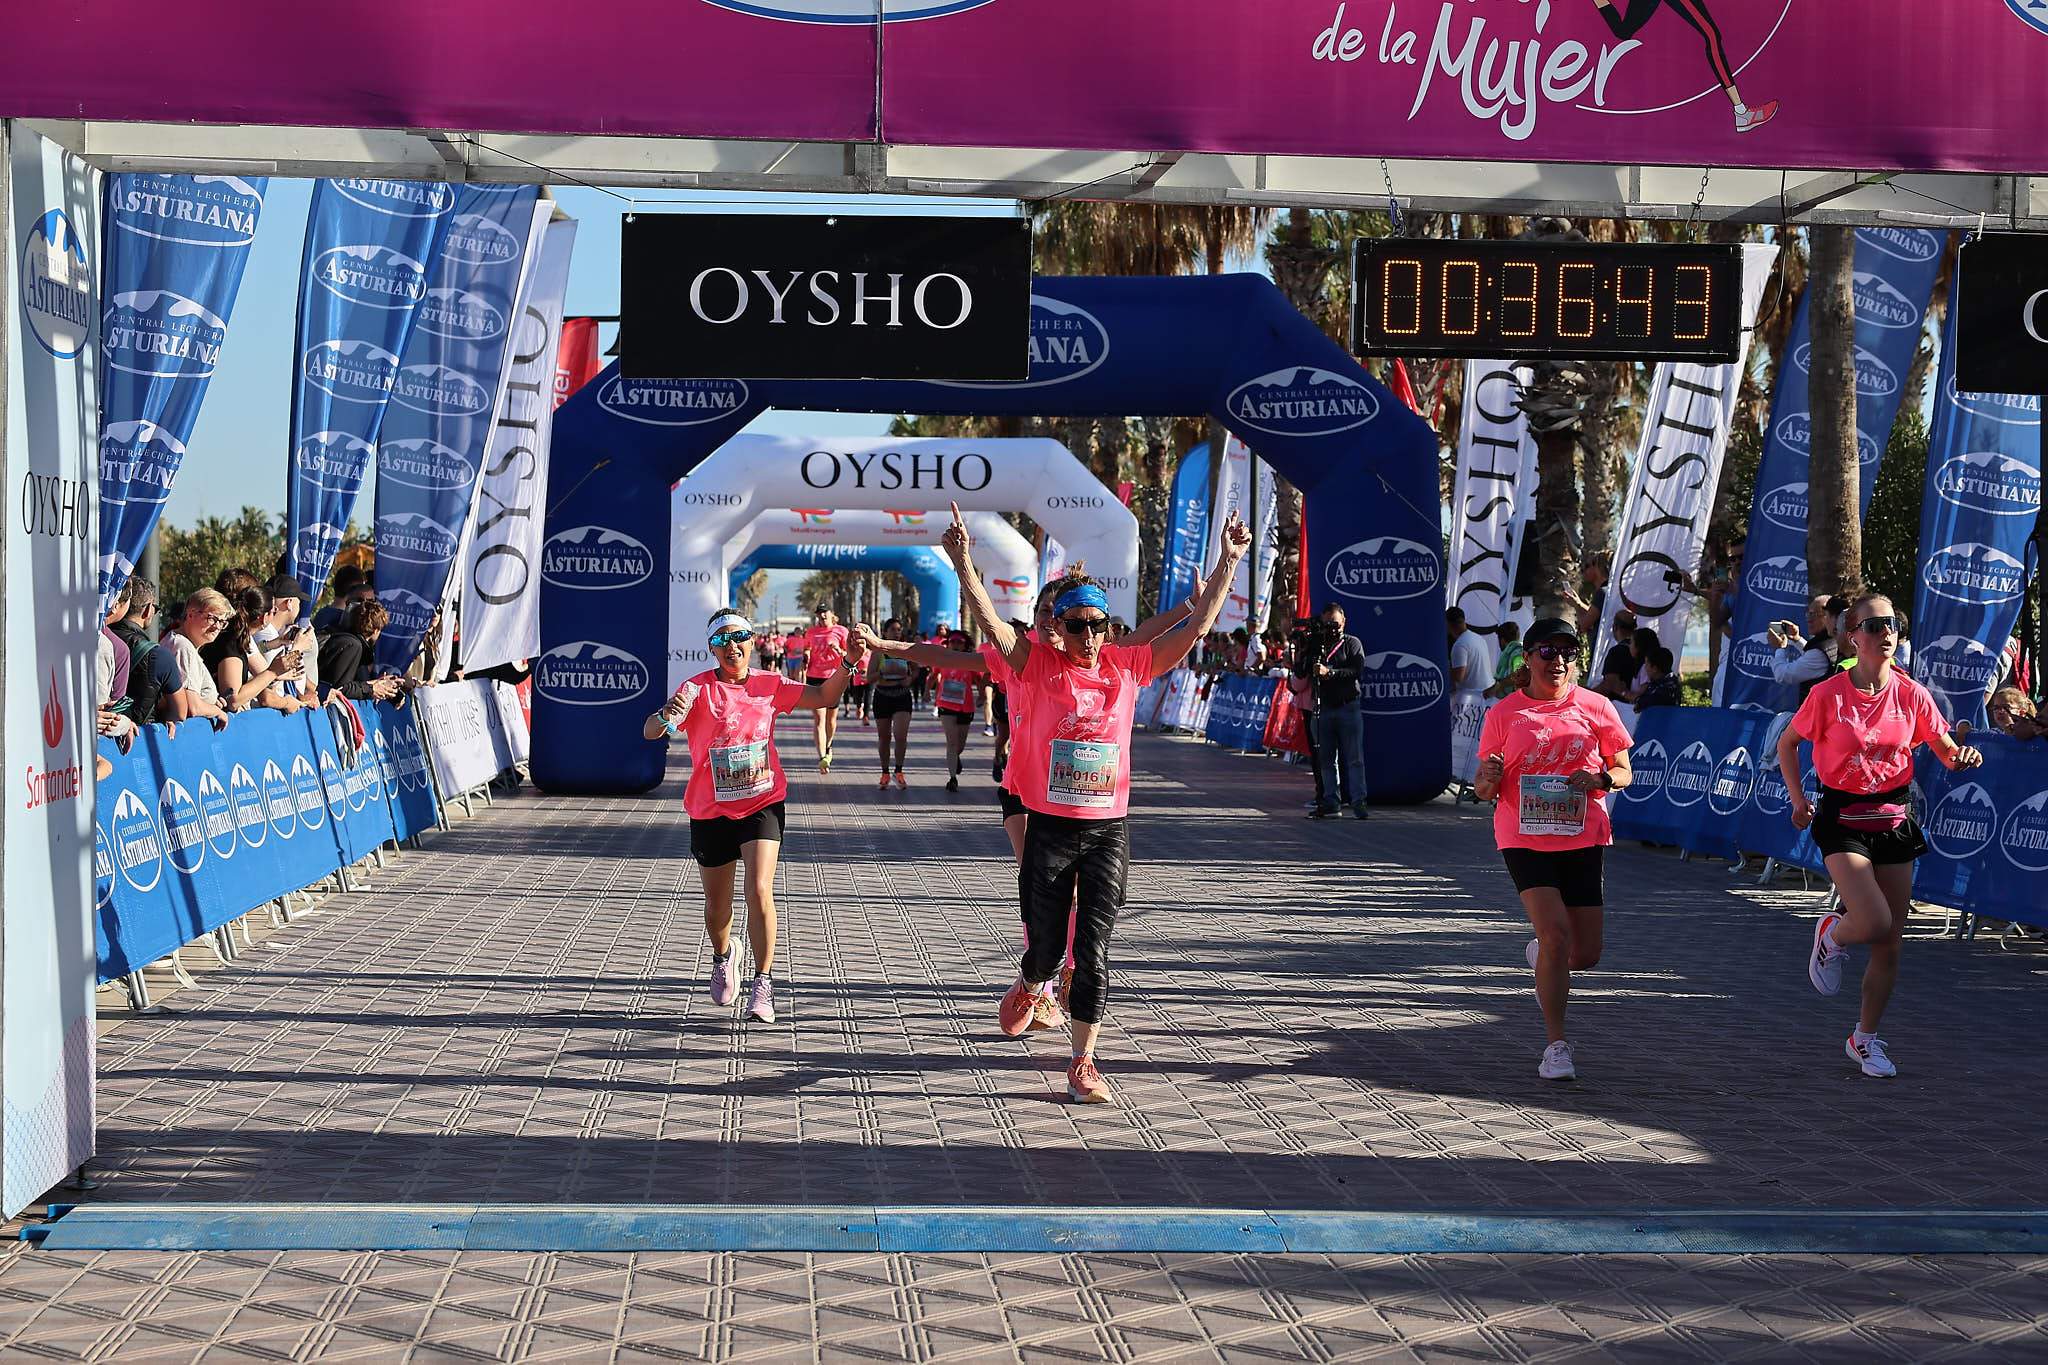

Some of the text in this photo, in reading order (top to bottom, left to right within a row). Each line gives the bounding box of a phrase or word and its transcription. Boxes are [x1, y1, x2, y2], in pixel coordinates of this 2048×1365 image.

[1312, 0, 1643, 140] de la Mujer
[132, 178, 256, 210] CENTRAL LECHERA
[321, 257, 419, 300] ASTURIAN
[342, 260, 384, 275] CENTRAL
[27, 251, 88, 329] ASTURIANA
[689, 267, 972, 329] OYSHO
[1383, 259, 1710, 339] 00:36:43
[420, 306, 495, 333] STURIANA
[107, 326, 220, 366] STURIANA
[308, 353, 394, 392] ASTURIAN
[631, 378, 735, 390] CENTRAL LECHERA
[606, 380, 737, 409] ASTURIANA
[1239, 394, 1370, 419] ASTURIANA
[1259, 388, 1362, 399] CENTRAL LECHERA
[379, 449, 465, 483] ASTURIANA
[801, 451, 992, 491] OYSHO
[21, 471, 90, 540] OYSHO
[684, 493, 742, 506] OYSHO
[1047, 496, 1104, 510] OYSHO
[1619, 372, 1725, 617] OYSH
[377, 533, 450, 557] STURIANA
[557, 548, 643, 556] CENTRAL LECHERA
[542, 549, 646, 576] ASTURIANA
[669, 571, 711, 583] YSHO
[1333, 561, 1435, 585] ASTURIANA
[1929, 560, 2020, 593] ASTURIANA
[1751, 569, 1808, 595] ASTURIA
[551, 662, 638, 672] CENTRAL LECHERA
[667, 649, 708, 663] YSHO
[538, 663, 641, 690] ASTURIANA
[26, 757, 84, 810] Santander
[163, 817, 203, 854] ASTURIANA
[1932, 807, 1989, 842] ASTURIANA
[117, 831, 160, 869] ASTURIANA
